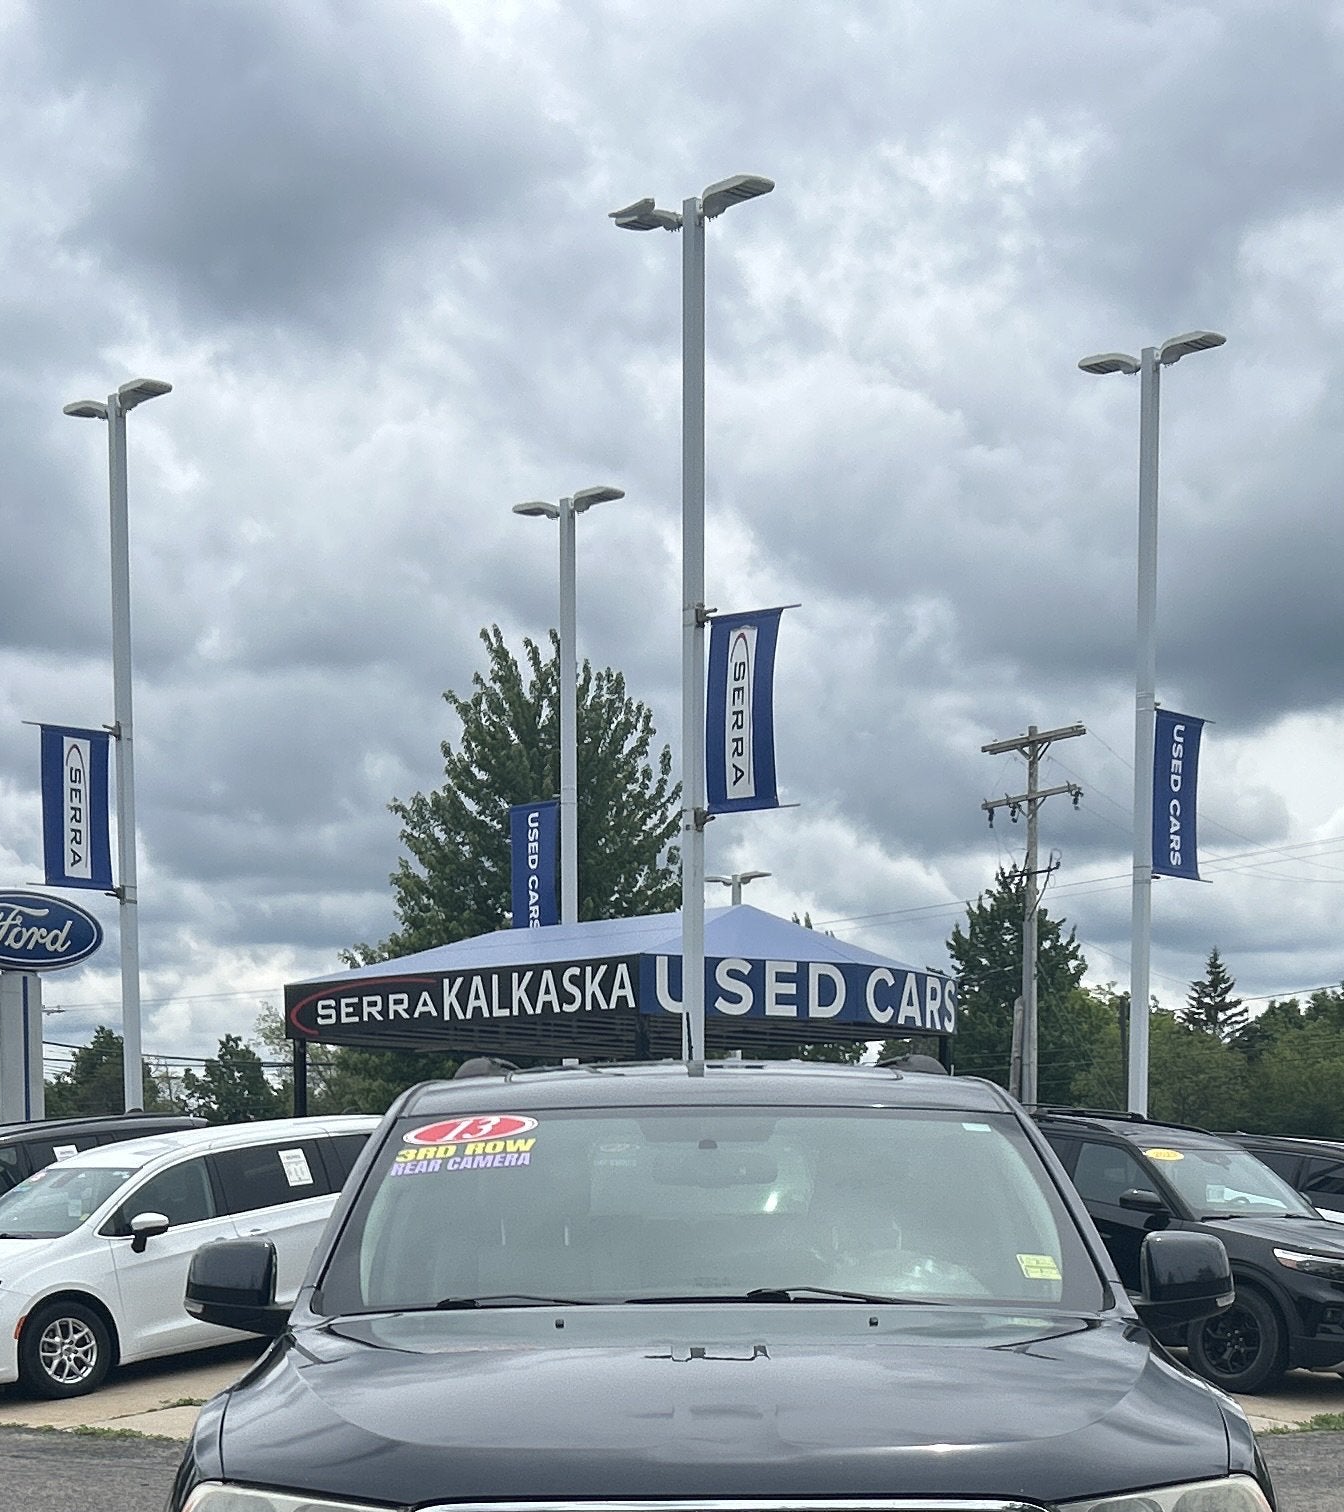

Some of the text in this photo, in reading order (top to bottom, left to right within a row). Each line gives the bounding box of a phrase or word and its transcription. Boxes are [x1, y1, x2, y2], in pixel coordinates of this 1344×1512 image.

[732, 662, 745, 786] SERRA
[70, 767, 82, 867] SERRA
[1170, 725, 1185, 866] USED CARS
[527, 811, 541, 929] USED CARS
[316, 963, 636, 1026] SERRA KALKASKA
[866, 967, 955, 1033] CARS
[395, 1138, 536, 1163] 3RD ROW
[436, 1116, 501, 1142] 13
[390, 1152, 531, 1177] REAR CAMERA
